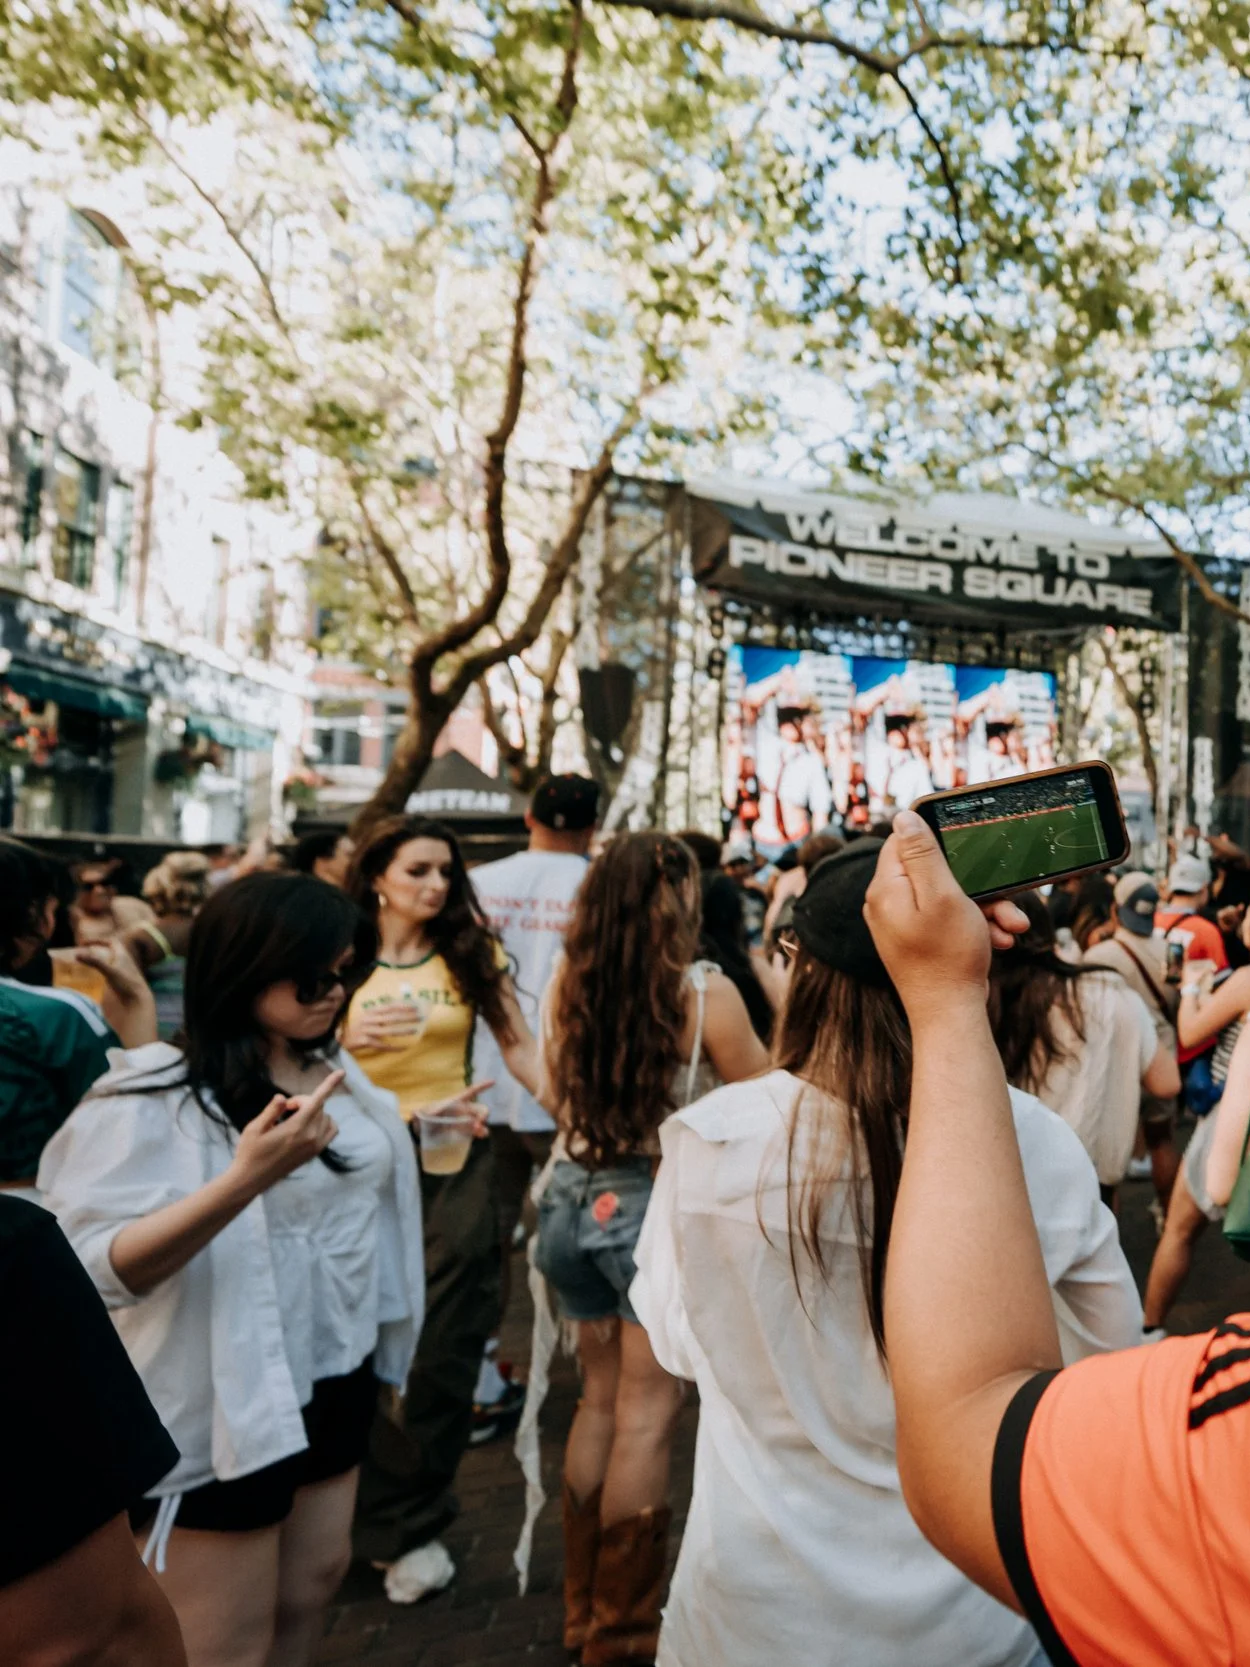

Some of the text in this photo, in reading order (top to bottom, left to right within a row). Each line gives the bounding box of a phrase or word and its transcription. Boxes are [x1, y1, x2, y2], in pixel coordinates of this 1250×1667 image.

[729, 535, 1154, 618] PIONEER SQUARE
[785, 511, 1110, 579] WELCOME TO
